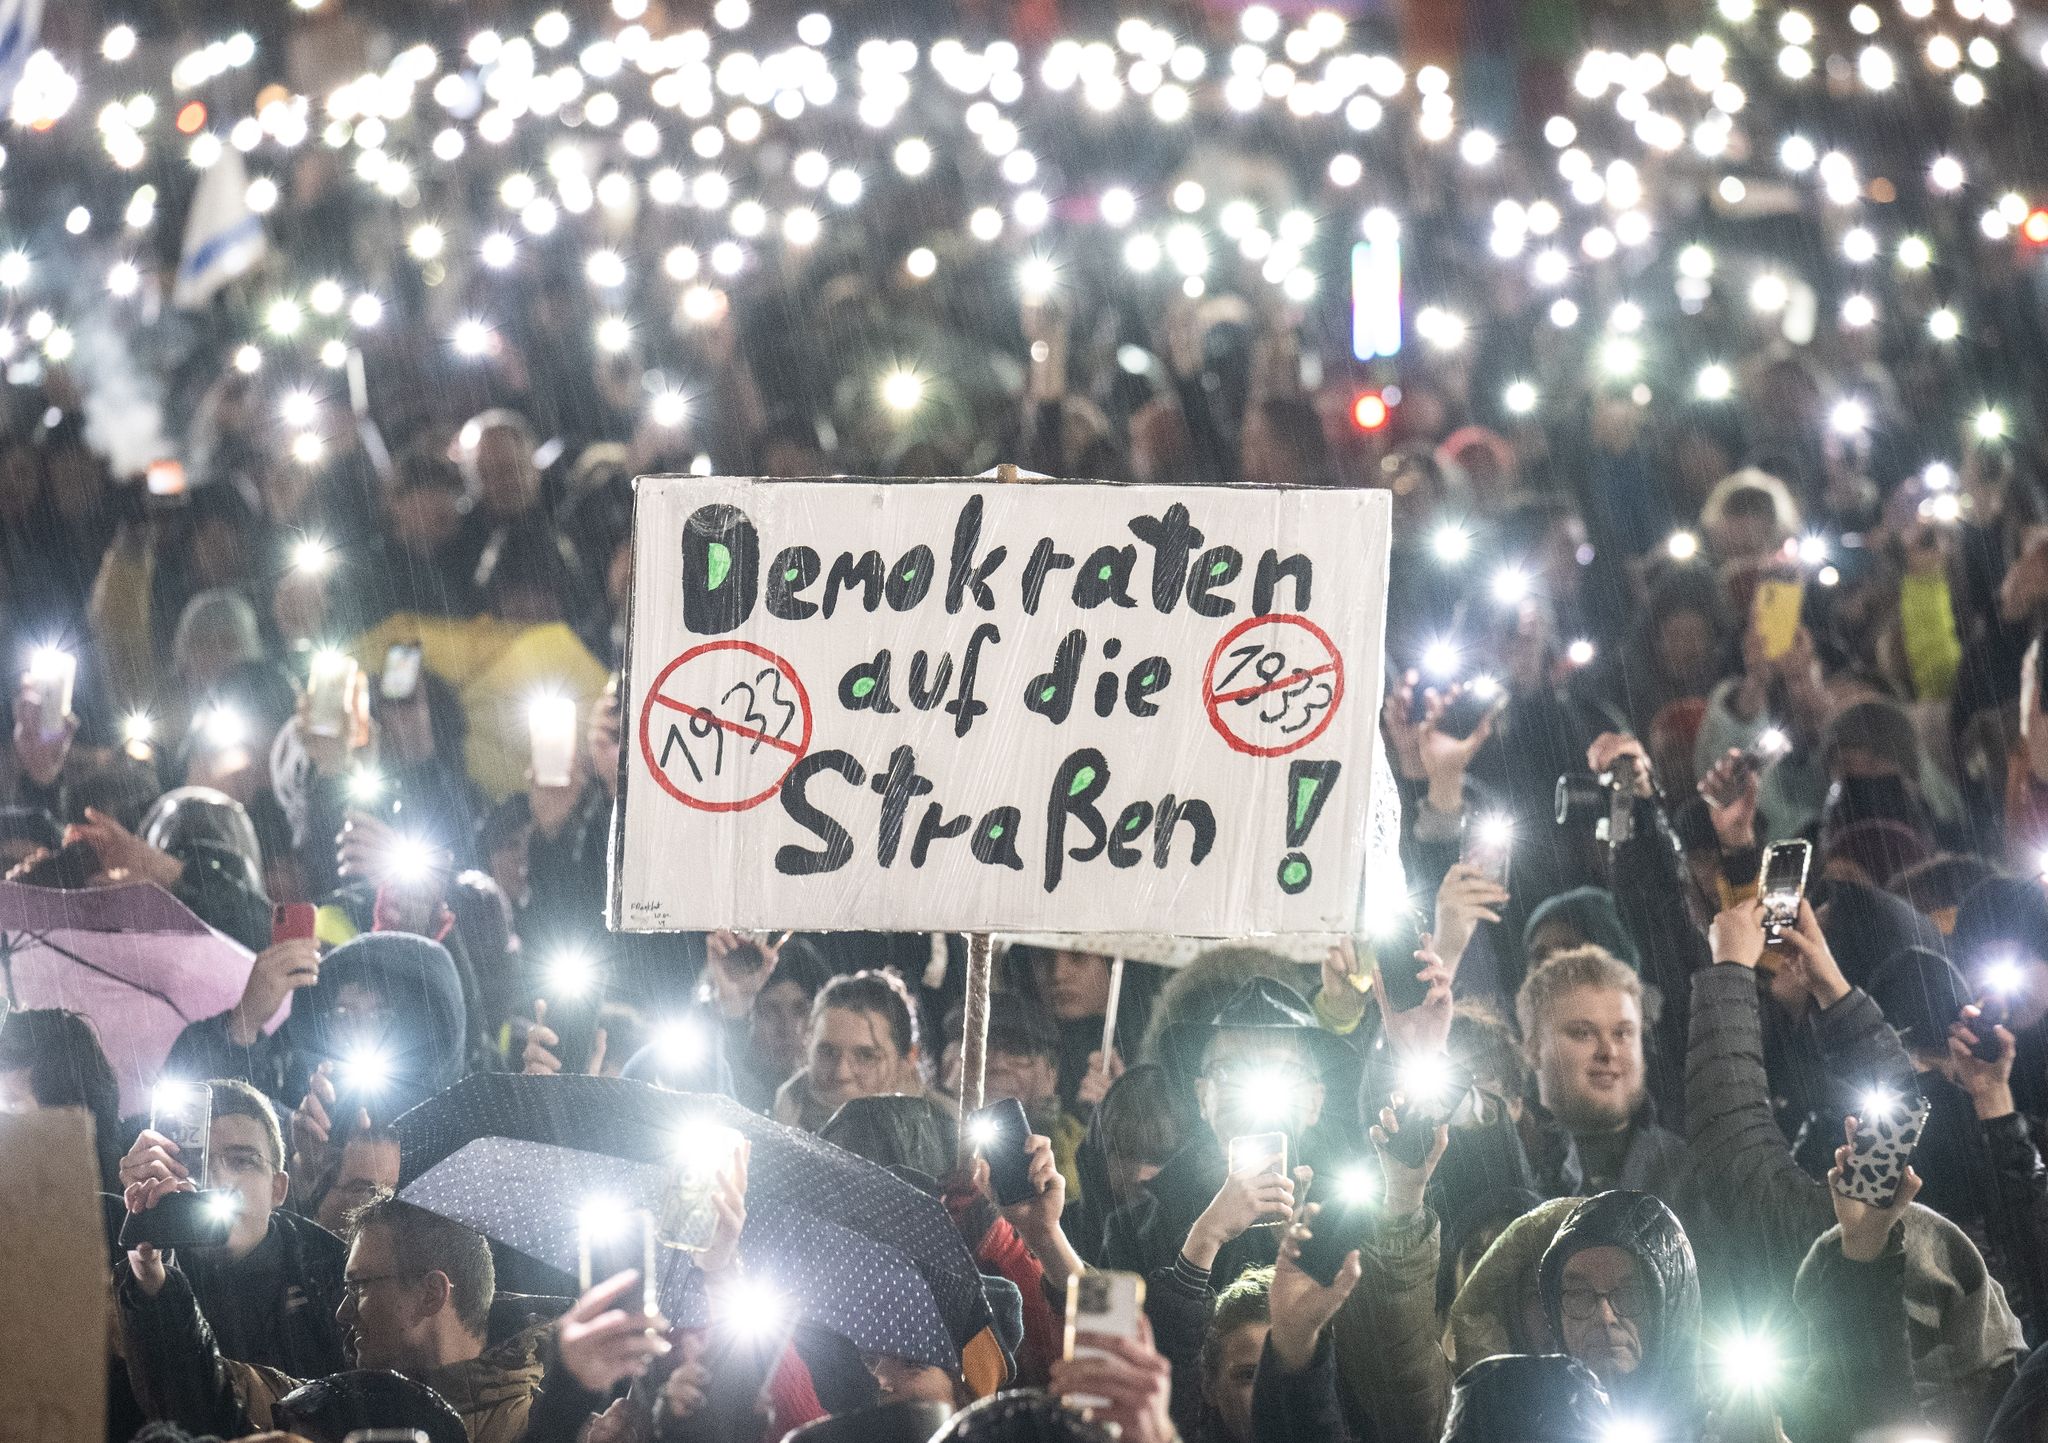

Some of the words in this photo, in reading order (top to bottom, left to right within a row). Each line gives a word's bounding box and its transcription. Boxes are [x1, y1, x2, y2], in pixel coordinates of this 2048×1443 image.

[682, 494, 1313, 635] Demokraten
[838, 623, 1001, 738] auf
[1023, 629, 1173, 724] die
[775, 745, 1217, 894] Straßen
